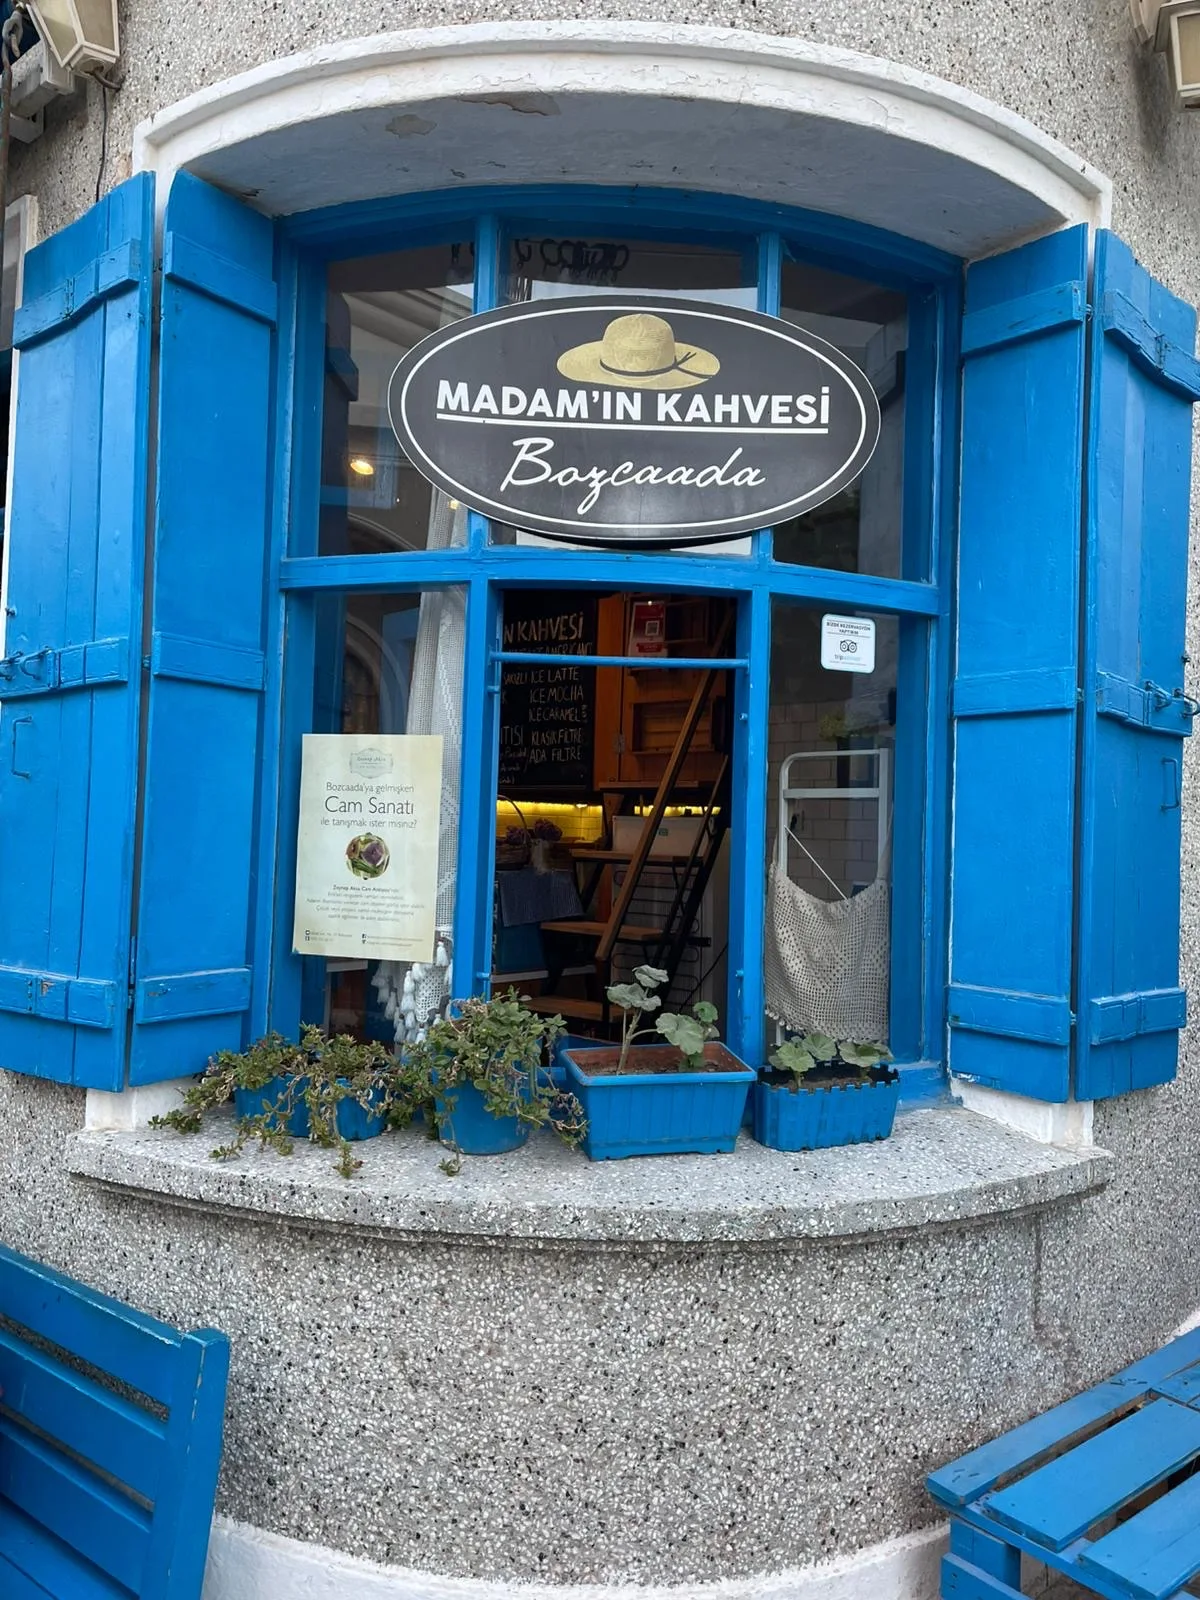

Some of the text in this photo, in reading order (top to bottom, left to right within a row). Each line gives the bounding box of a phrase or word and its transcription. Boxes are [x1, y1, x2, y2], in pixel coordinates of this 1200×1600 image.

[436, 380, 829, 424] MADAM'IN KAHVESİ
[500, 437, 767, 515] Bozcaada
[547, 666, 580, 683] LATTE
[325, 795, 414, 815] Cam Sanatı
